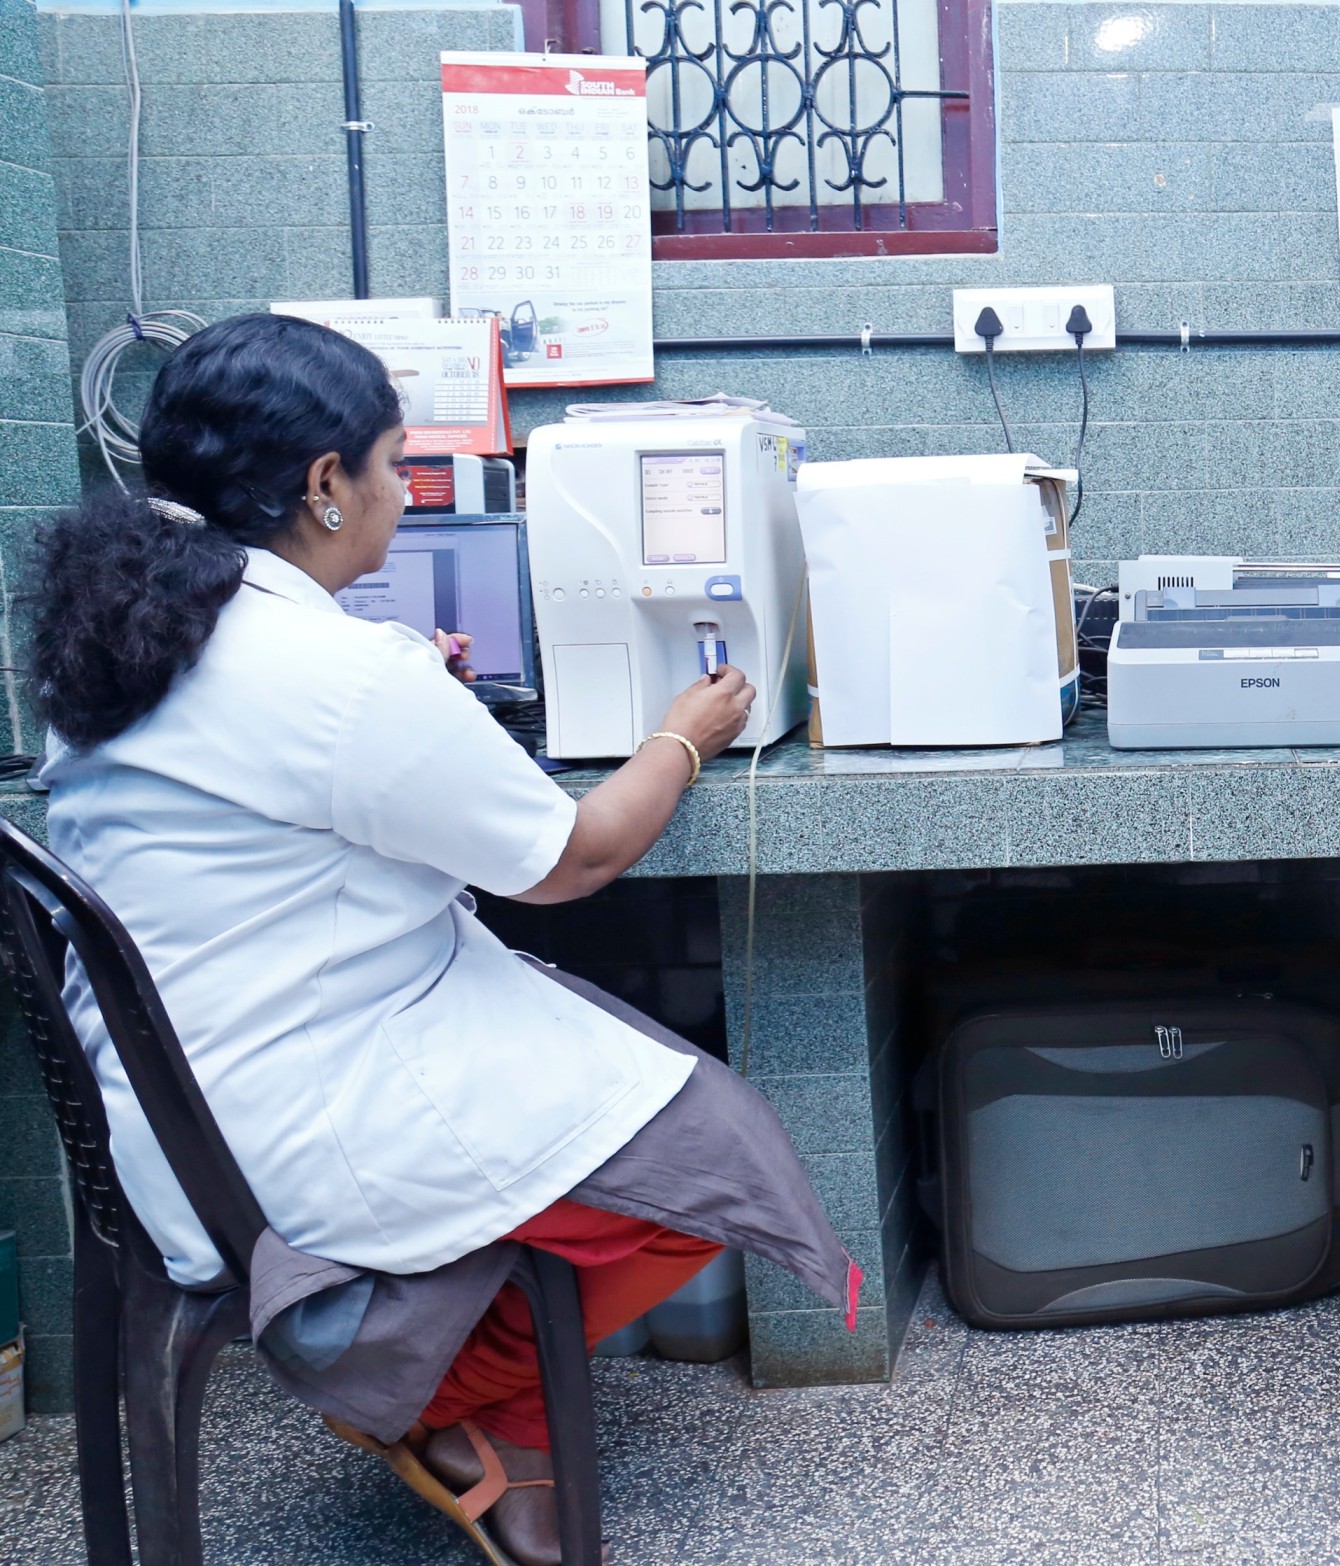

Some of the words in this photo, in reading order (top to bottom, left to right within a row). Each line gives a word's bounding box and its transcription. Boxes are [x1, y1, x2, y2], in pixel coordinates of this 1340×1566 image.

[455, 105, 479, 114] 2018
[453, 122, 472, 130] SUN
[480, 122, 501, 130] MON
[511, 122, 527, 130] TUE
[537, 122, 557, 130] WED
[566, 122, 584, 130] THU
[595, 122, 609, 130] FRI
[489, 146, 494, 159] 1
[516, 146, 524, 159] 2
[544, 146, 551, 159] 3
[572, 146, 579, 159] 4
[600, 147, 607, 159] 5
[626, 147, 635, 159] 6
[461, 176, 469, 189] 7
[489, 176, 497, 189] 8
[516, 176, 526, 189] 9
[542, 176, 556, 189] 10
[571, 176, 582, 189] 11
[598, 176, 611, 189] 12
[625, 176, 639, 189] 13
[459, 206, 473, 219] 14
[488, 206, 501, 219] 15
[515, 206, 530, 219] 16
[544, 206, 556, 219] 17
[571, 206, 585, 219] 18
[598, 206, 612, 219] 19
[624, 206, 641, 218] 20
[461, 236, 475, 249] 21
[488, 236, 504, 249] 22
[515, 236, 532, 249] 23
[544, 236, 560, 249] 24
[571, 236, 587, 249] 25
[598, 235, 615, 248] 26
[626, 235, 641, 248] 27
[461, 267, 478, 280] 28
[489, 266, 506, 280] 29
[516, 266, 534, 280] 30
[546, 266, 560, 279] 31
[1241, 678, 1280, 688] EPSON
